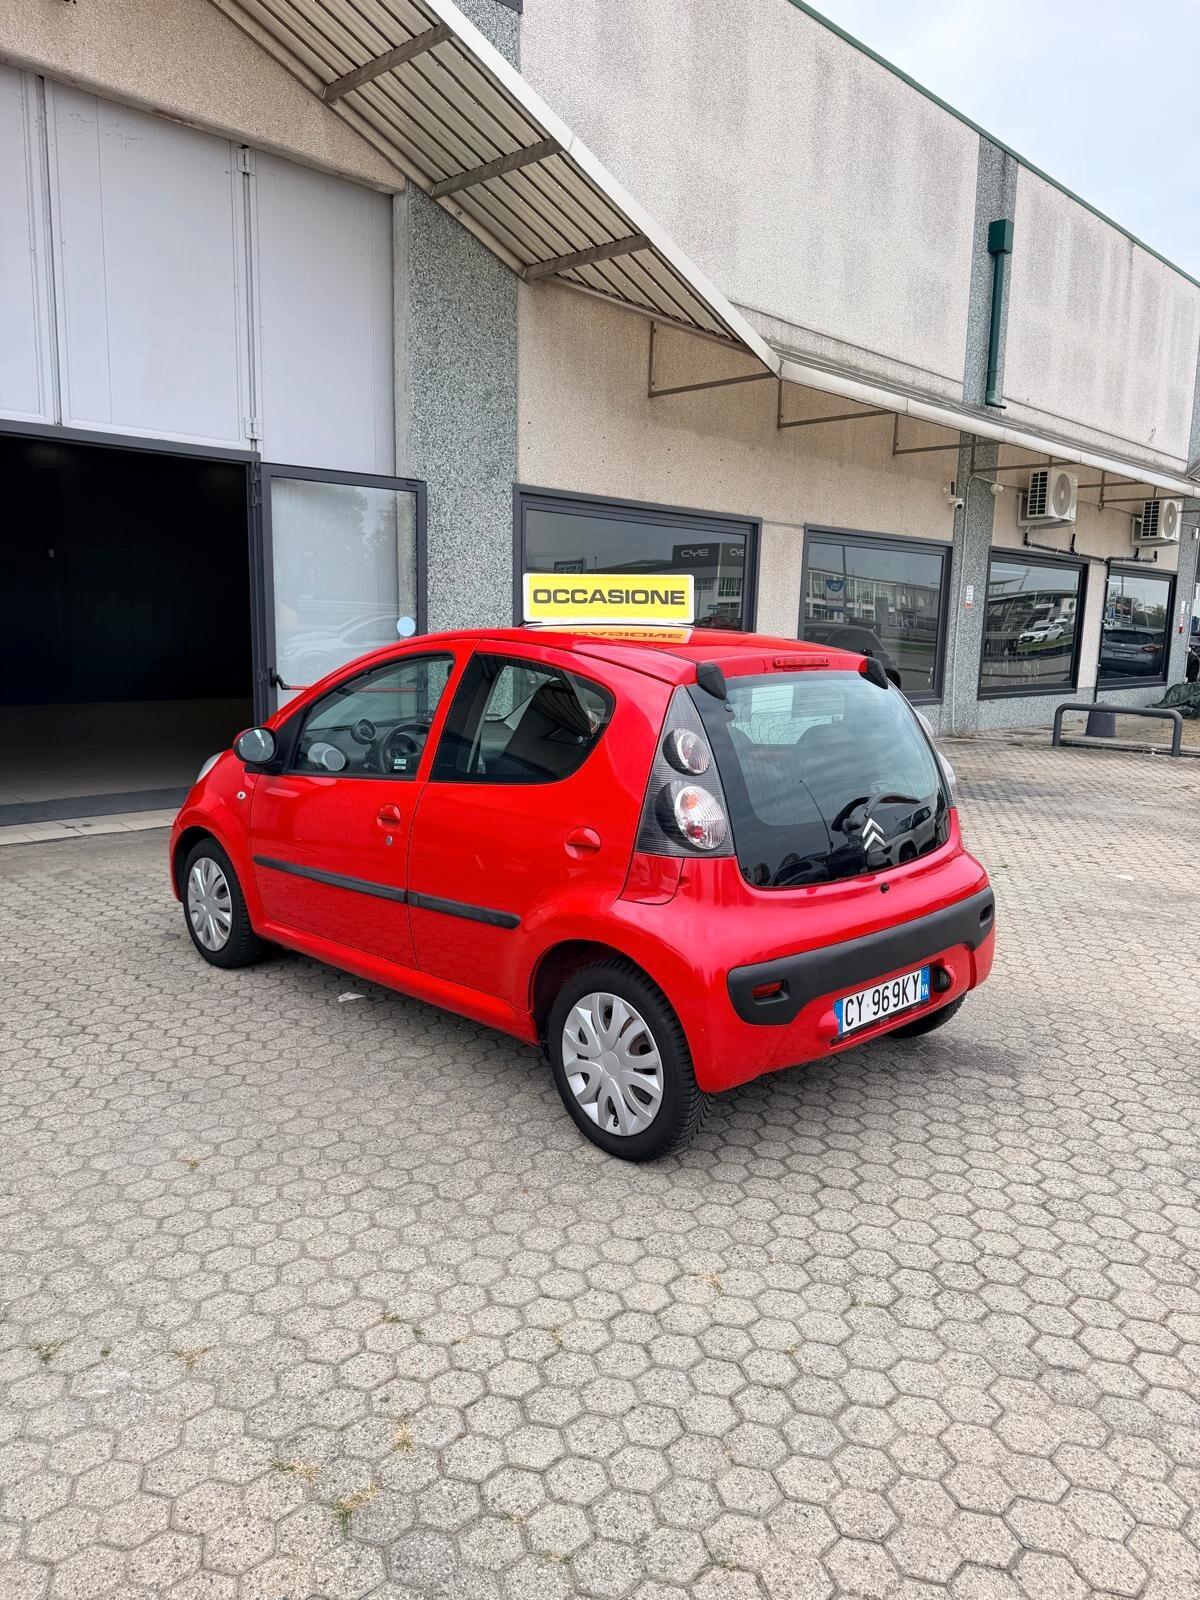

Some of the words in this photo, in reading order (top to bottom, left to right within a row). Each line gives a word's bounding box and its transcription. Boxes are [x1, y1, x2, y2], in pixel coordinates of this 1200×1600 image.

[533, 589, 685, 605] OCCASIONE
[921, 983, 929, 995] VA
[845, 994, 864, 1027] CY
[872, 973, 919, 1016] 969KY
